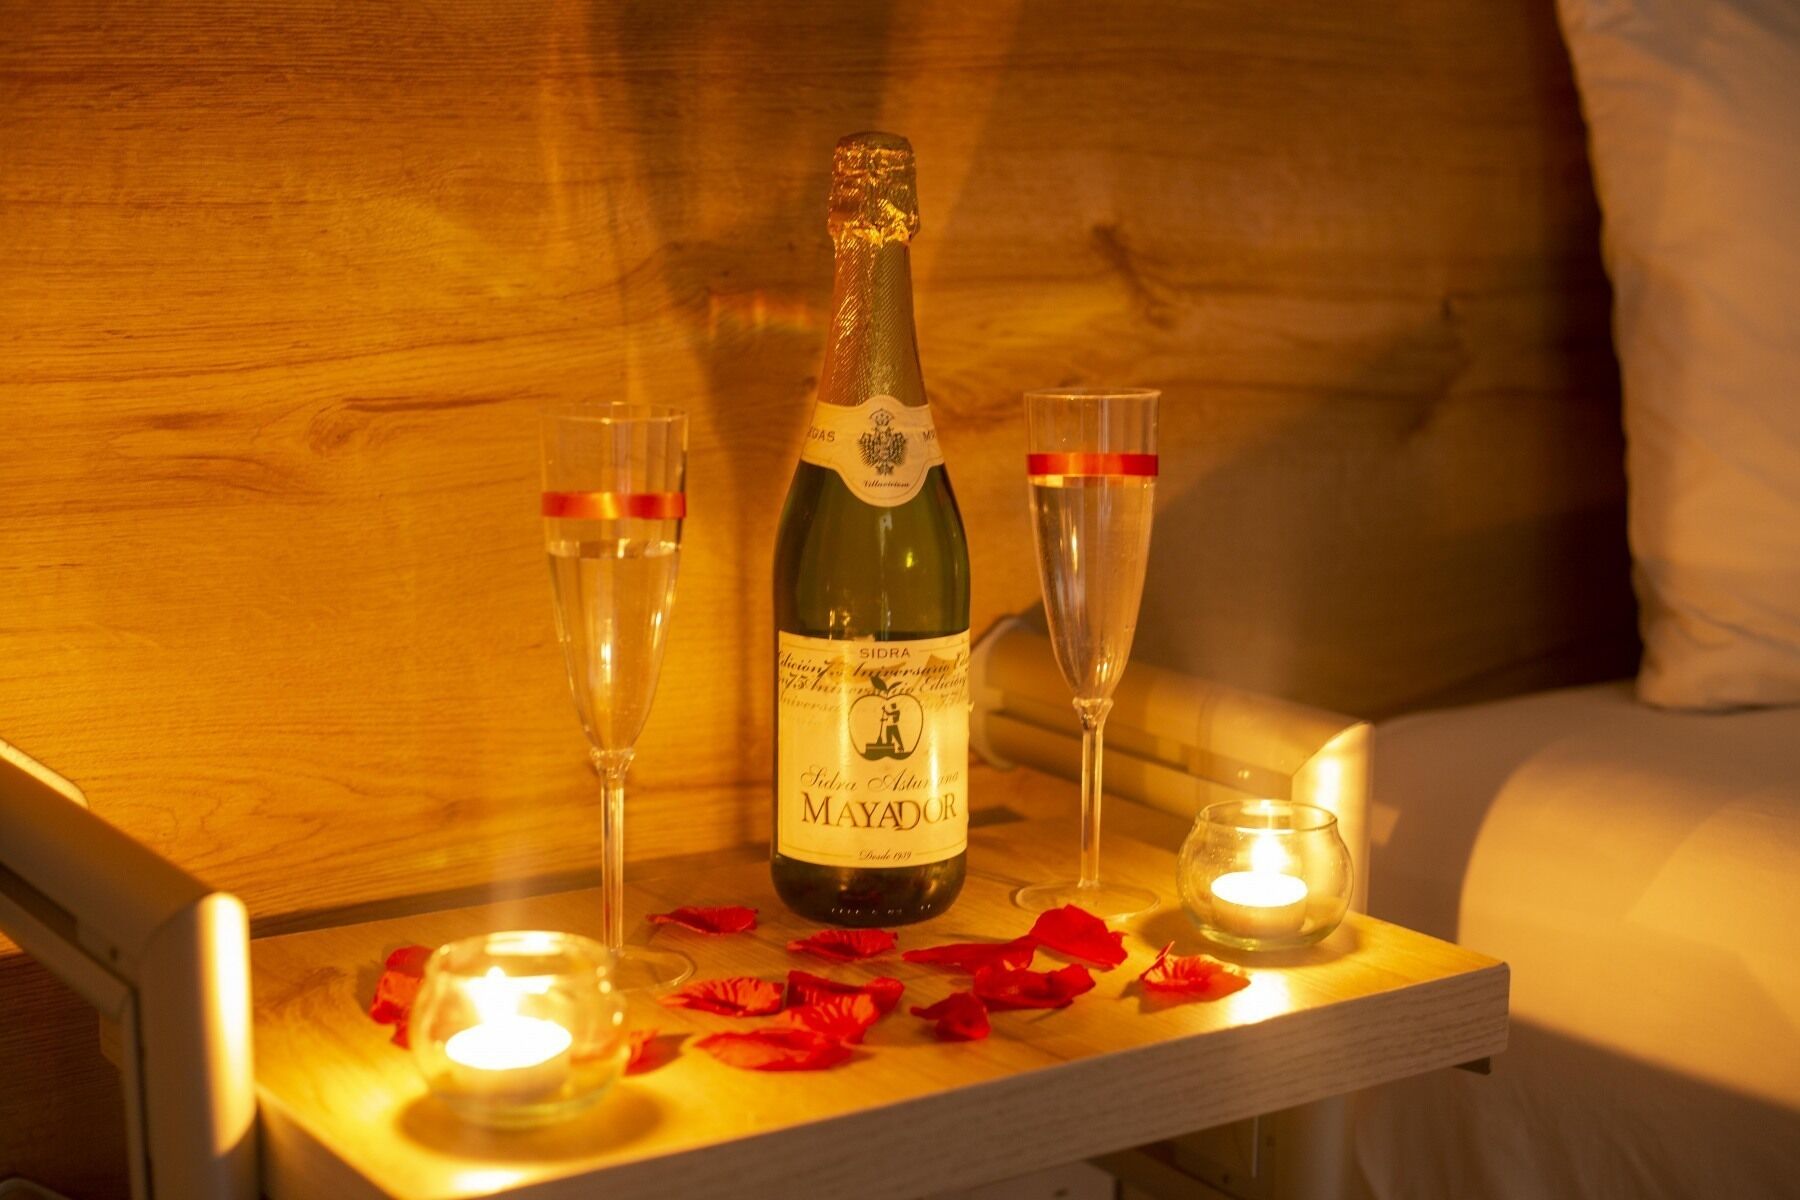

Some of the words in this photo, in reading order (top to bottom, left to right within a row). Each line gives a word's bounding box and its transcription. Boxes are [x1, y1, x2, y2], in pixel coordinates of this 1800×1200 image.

[858, 647, 911, 659] SIDRA
[800, 765, 857, 792] Sidra
[868, 767, 959, 792] Asturana
[801, 791, 957, 831] MAYADOR
[858, 848, 891, 861] Desde
